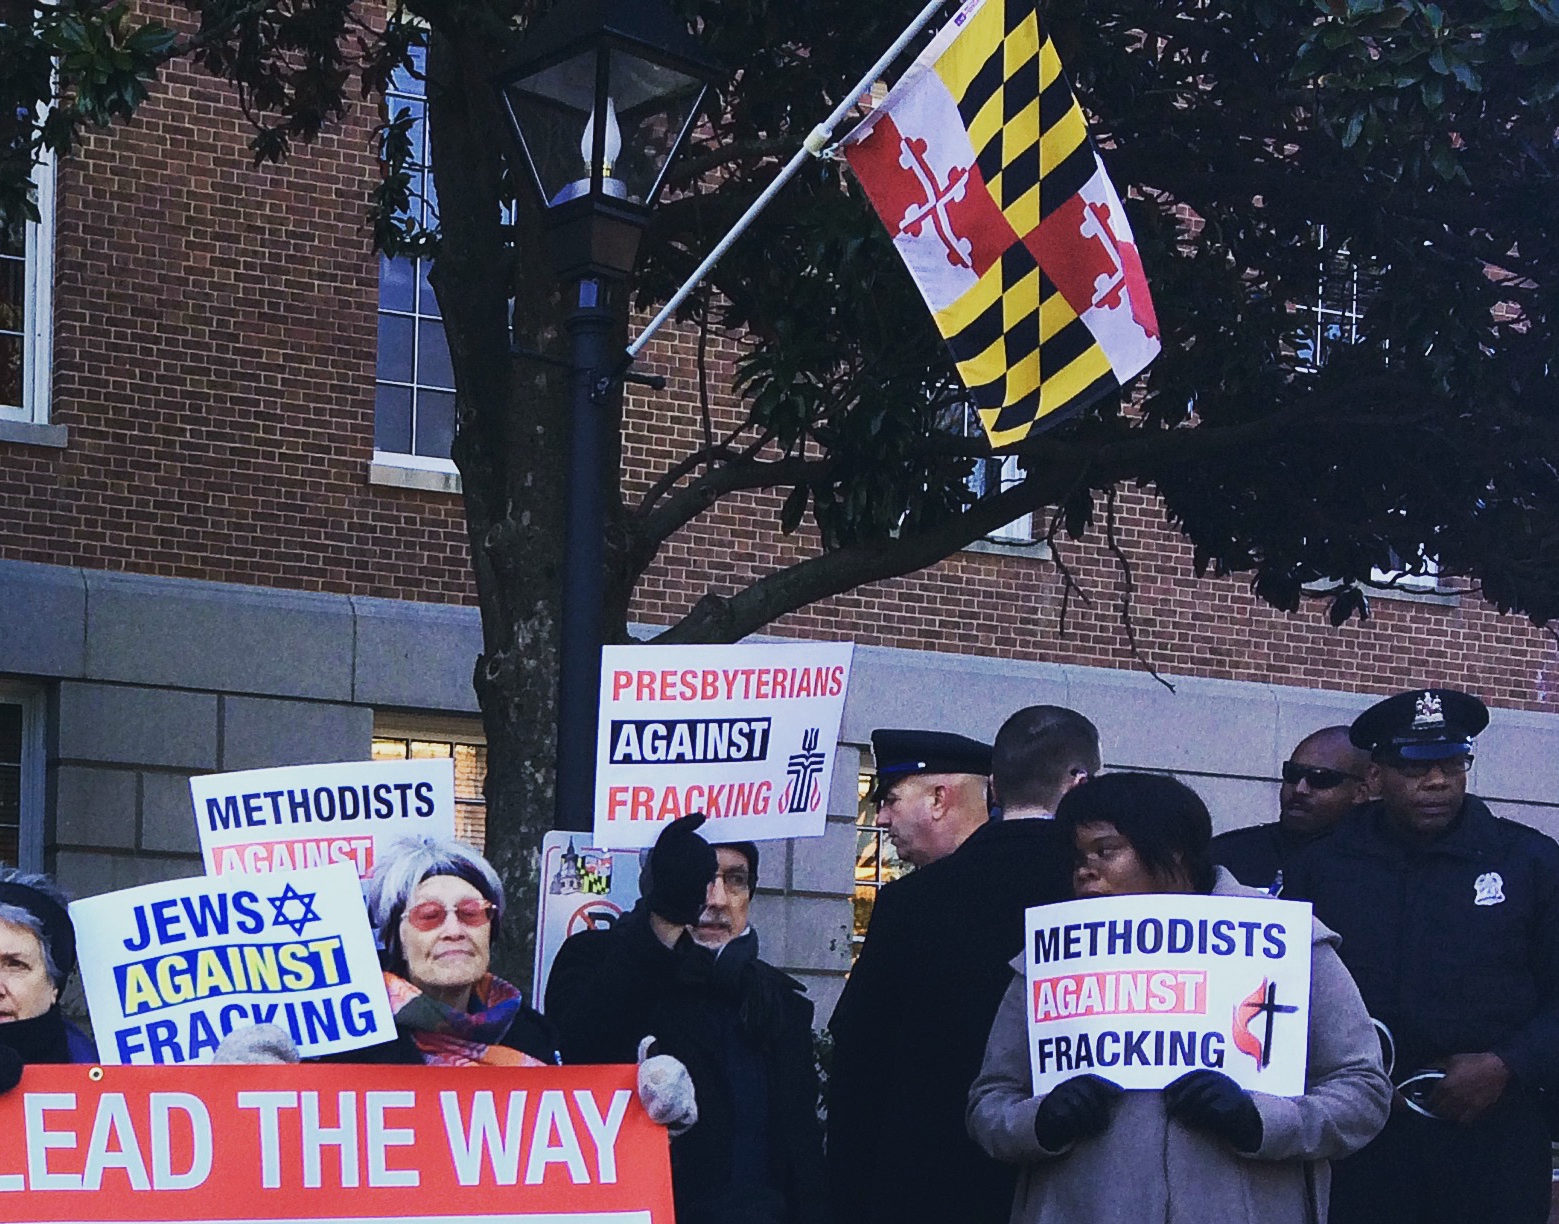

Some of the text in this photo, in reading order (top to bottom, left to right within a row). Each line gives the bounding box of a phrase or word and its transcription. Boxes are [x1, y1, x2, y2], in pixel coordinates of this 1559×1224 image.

[612, 665, 845, 702] PRESBYTERIANS
[612, 721, 769, 761] AGAINST
[205, 782, 436, 832] METHODISTS
[607, 780, 773, 821] FRACKING
[215, 839, 373, 877] AGAINST
[123, 890, 265, 952] JEWS
[1034, 917, 1287, 965] METHODISTS
[124, 940, 342, 1015] AGAINST
[1037, 972, 1205, 1020] AGAINST
[1038, 1030, 1226, 1074] FRACKING
[238, 1090, 421, 1189] THE
[440, 1089, 633, 1187] WAY
